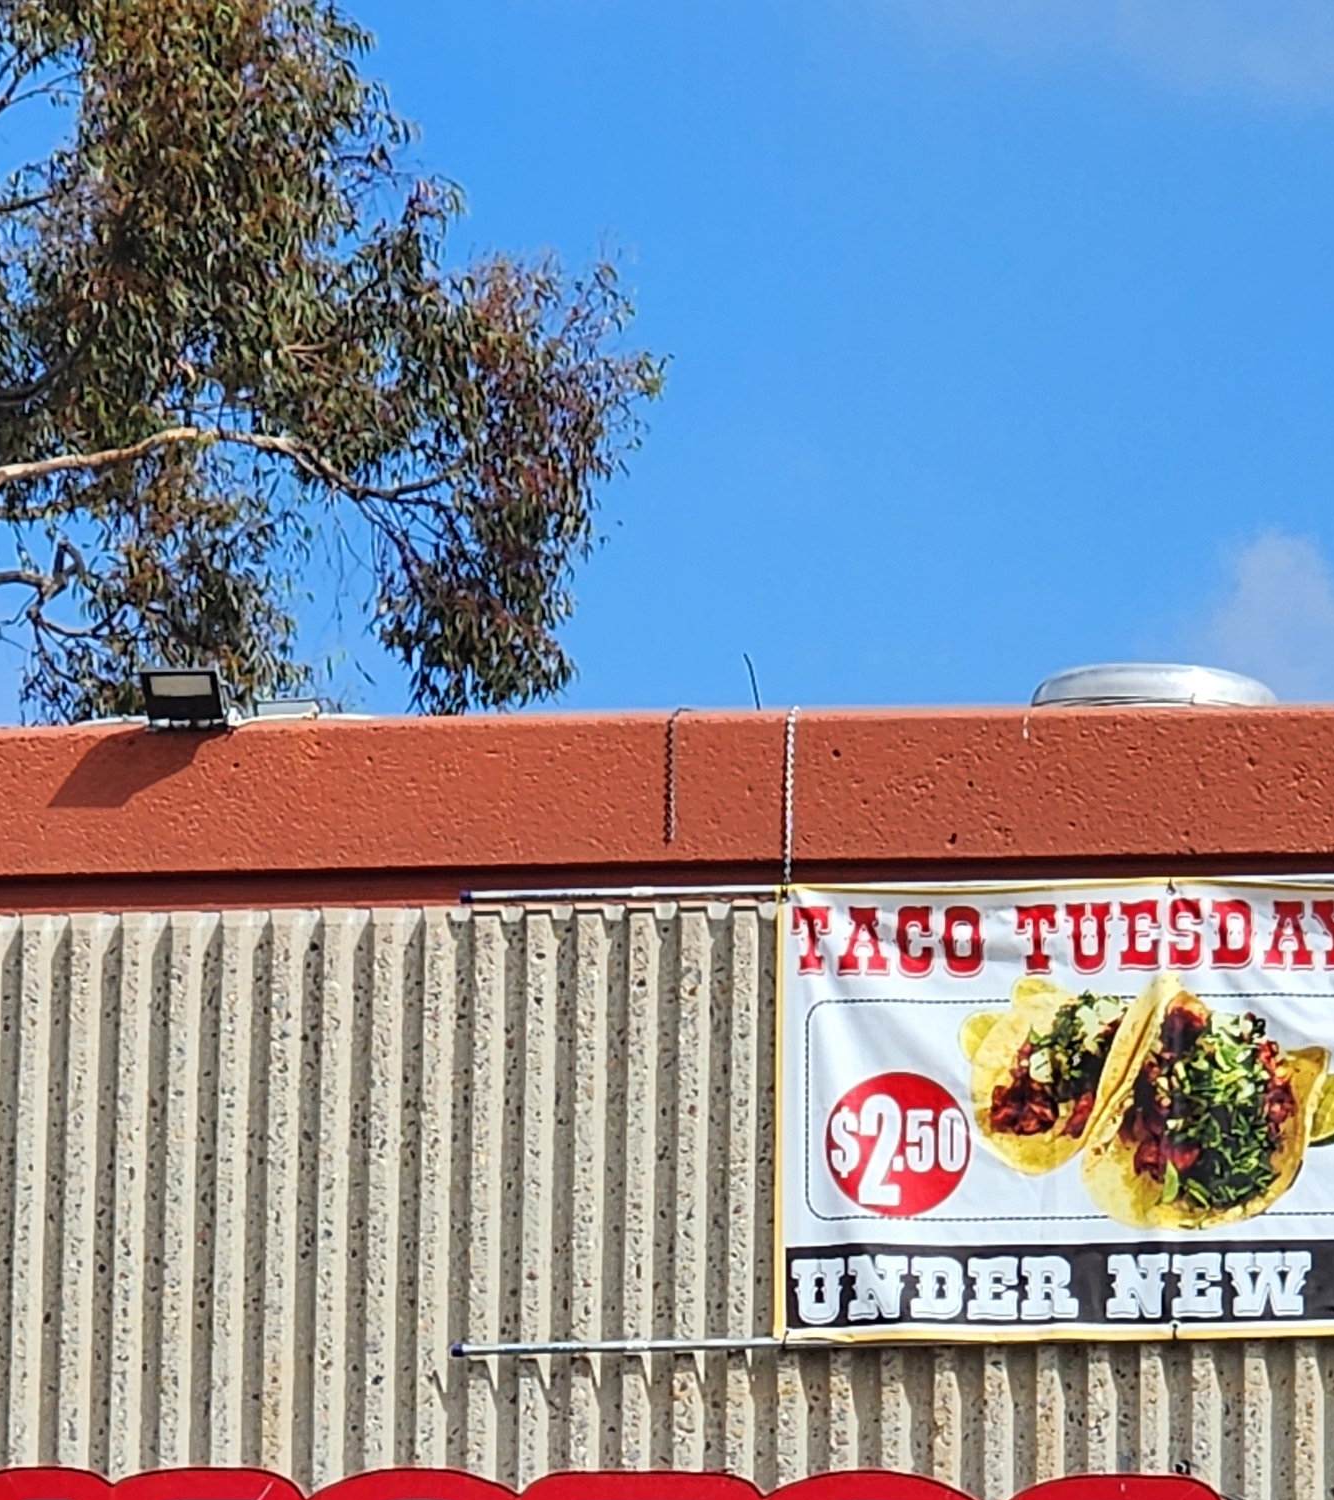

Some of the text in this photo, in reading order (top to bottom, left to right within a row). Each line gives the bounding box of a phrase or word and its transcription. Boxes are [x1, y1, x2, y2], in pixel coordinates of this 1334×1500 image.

[790, 904, 985, 977] TACO
[830, 1093, 967, 1207] $2.50
[790, 1252, 1079, 1325] UNDER
[1105, 1249, 1313, 1319] NEW
